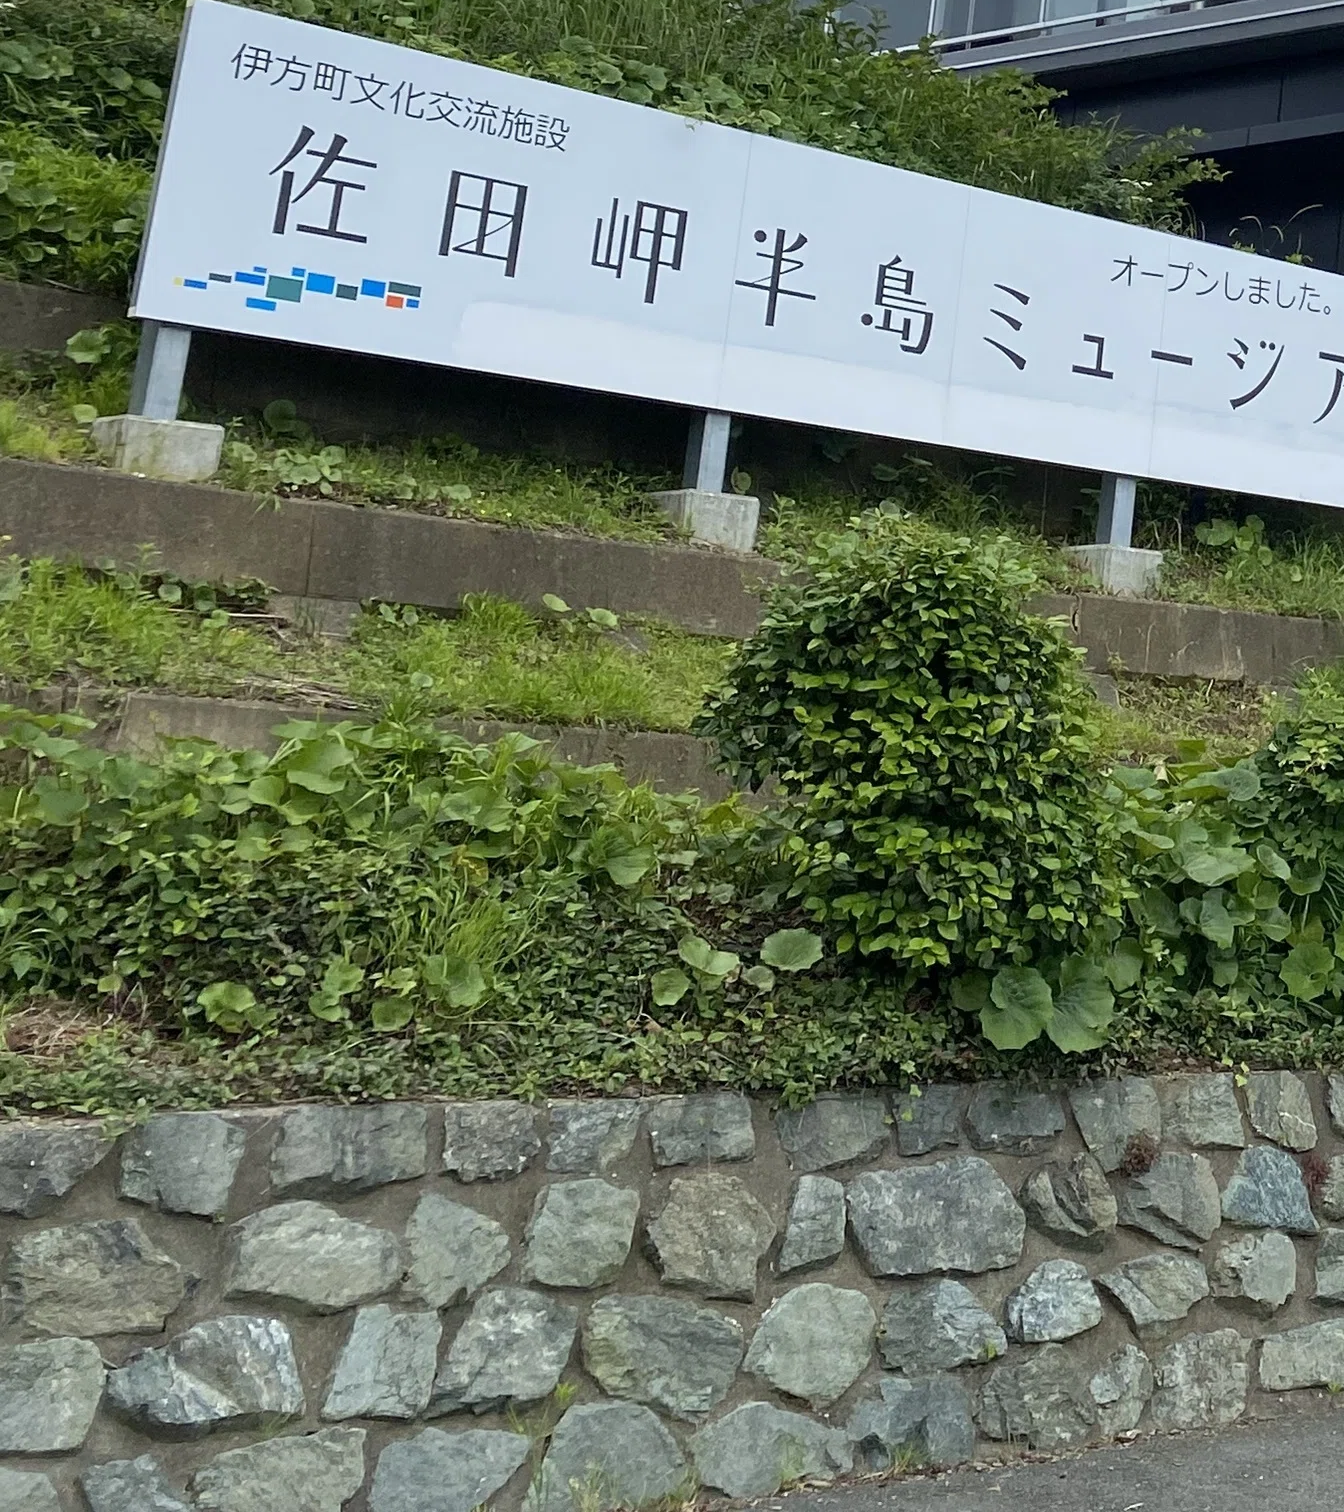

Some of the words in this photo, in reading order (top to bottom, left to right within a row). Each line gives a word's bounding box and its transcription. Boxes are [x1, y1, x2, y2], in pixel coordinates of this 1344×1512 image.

[231, 43, 571, 152] 伊方町文化交流施設
[1110, 255, 1332, 316] オープンしました。
